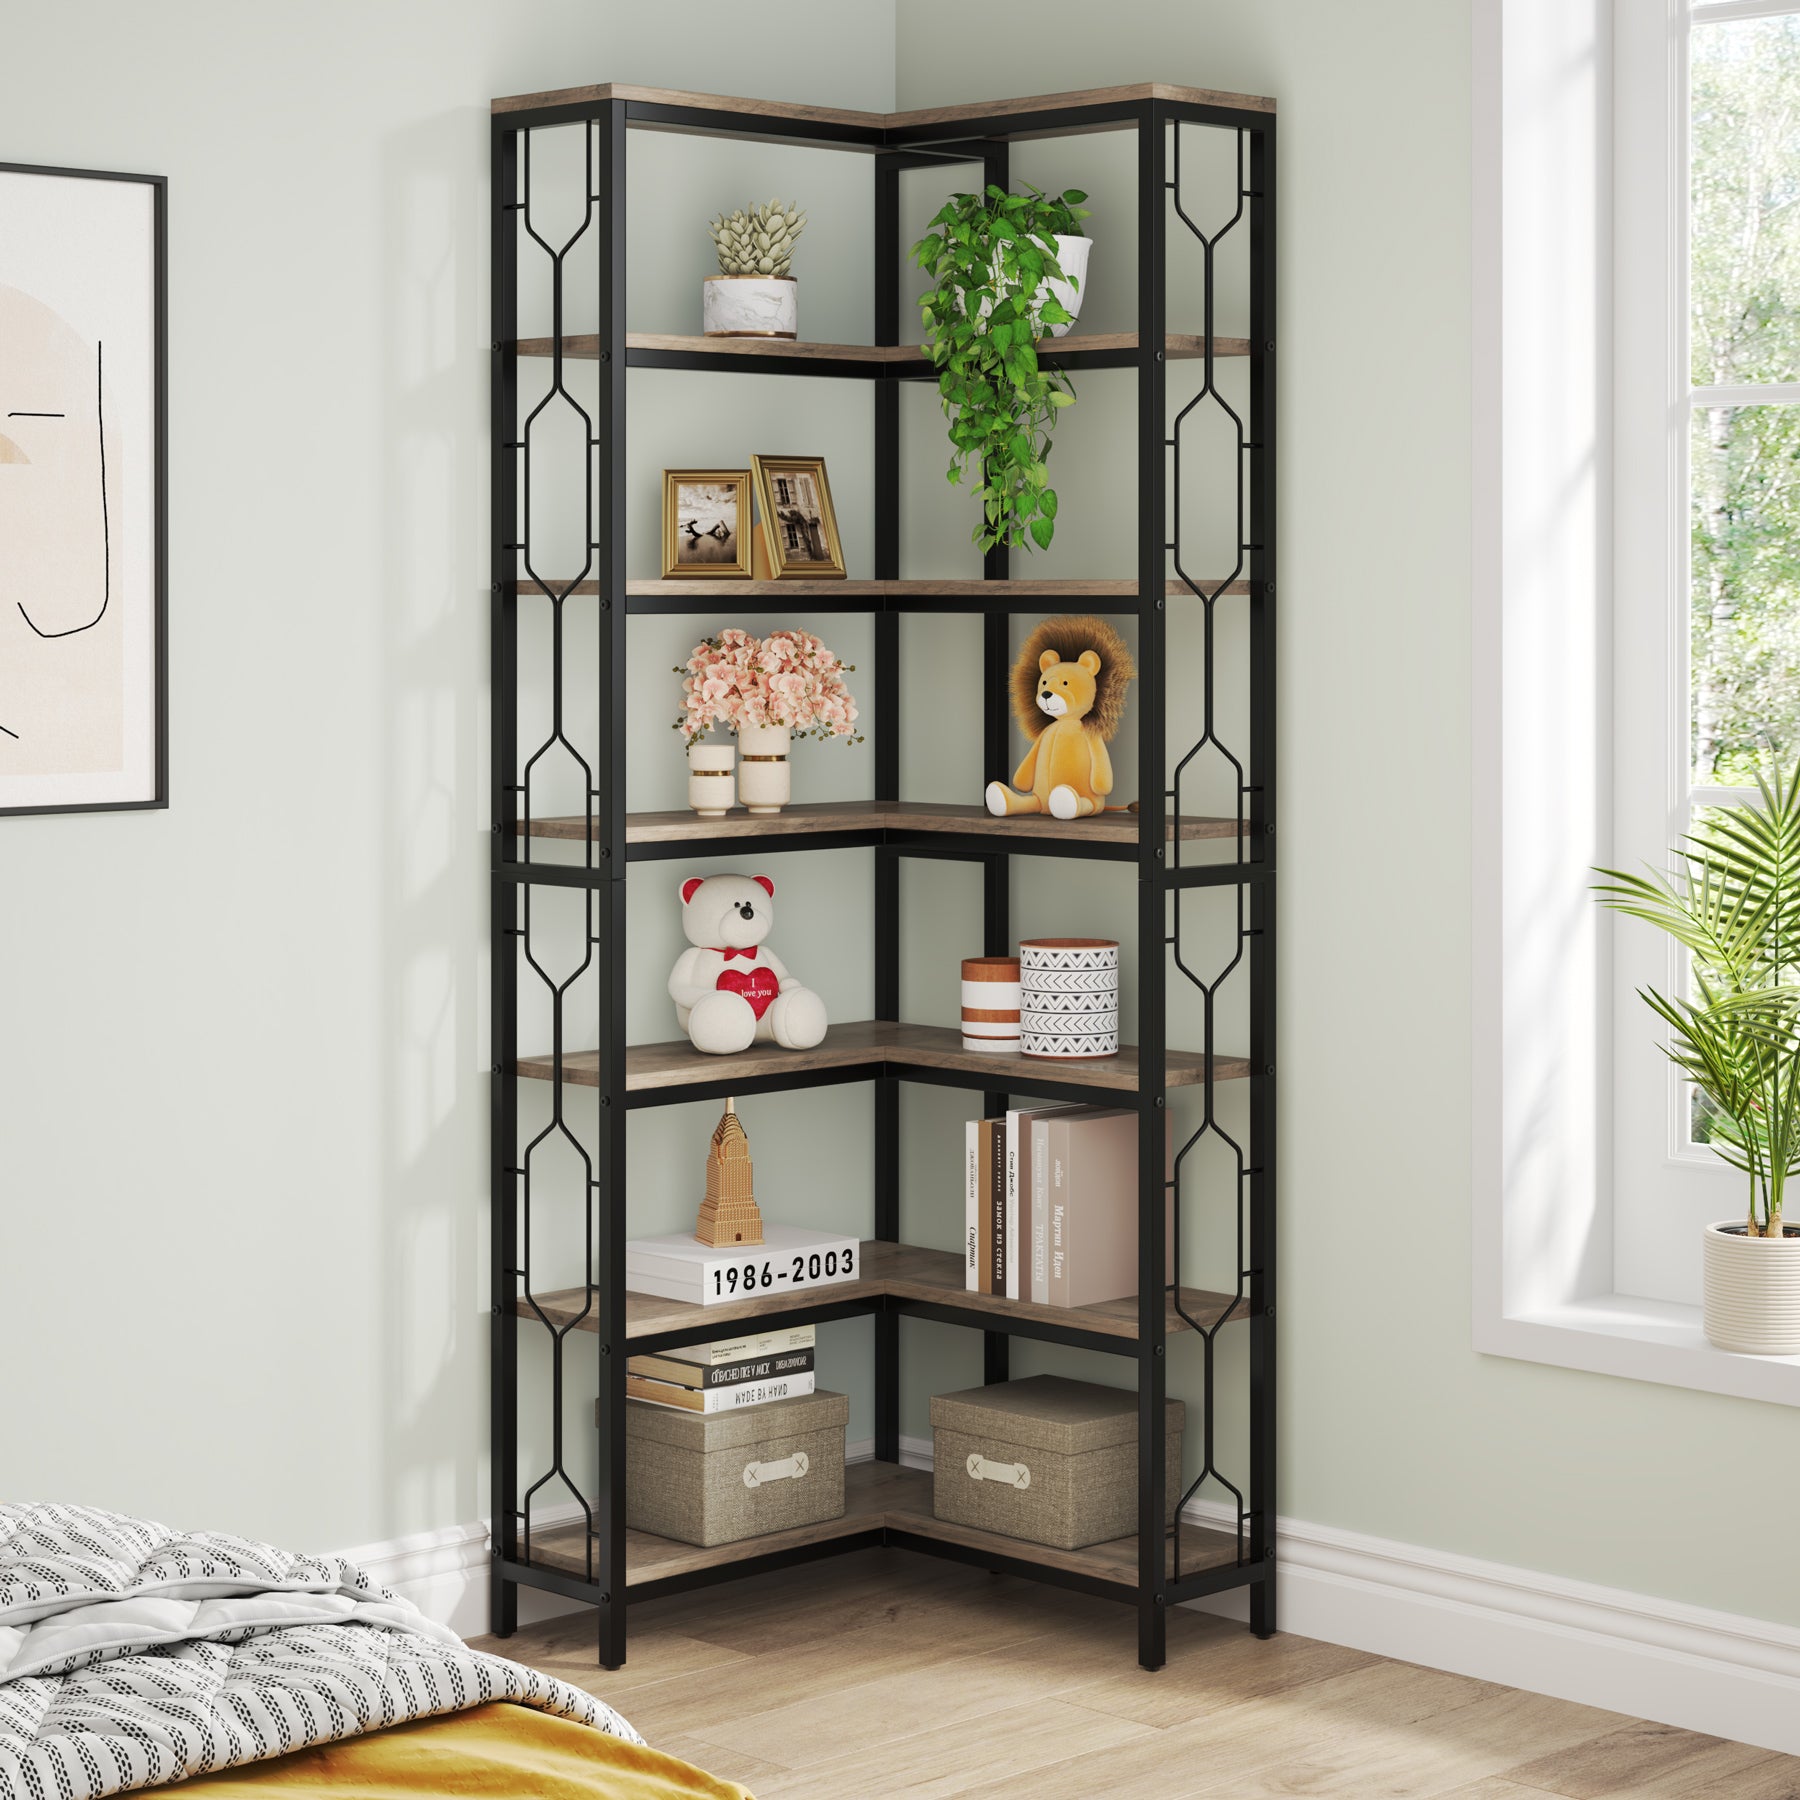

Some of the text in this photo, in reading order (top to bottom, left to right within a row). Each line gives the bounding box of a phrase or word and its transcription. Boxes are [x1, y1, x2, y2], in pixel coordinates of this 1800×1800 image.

[741, 989, 772, 999] love you
[751, 978, 756, 988] I
[1053, 1204, 1064, 1247] Мартин
[968, 1226, 977, 1270] Спартак
[713, 1248, 853, 1296] 1986-2003
